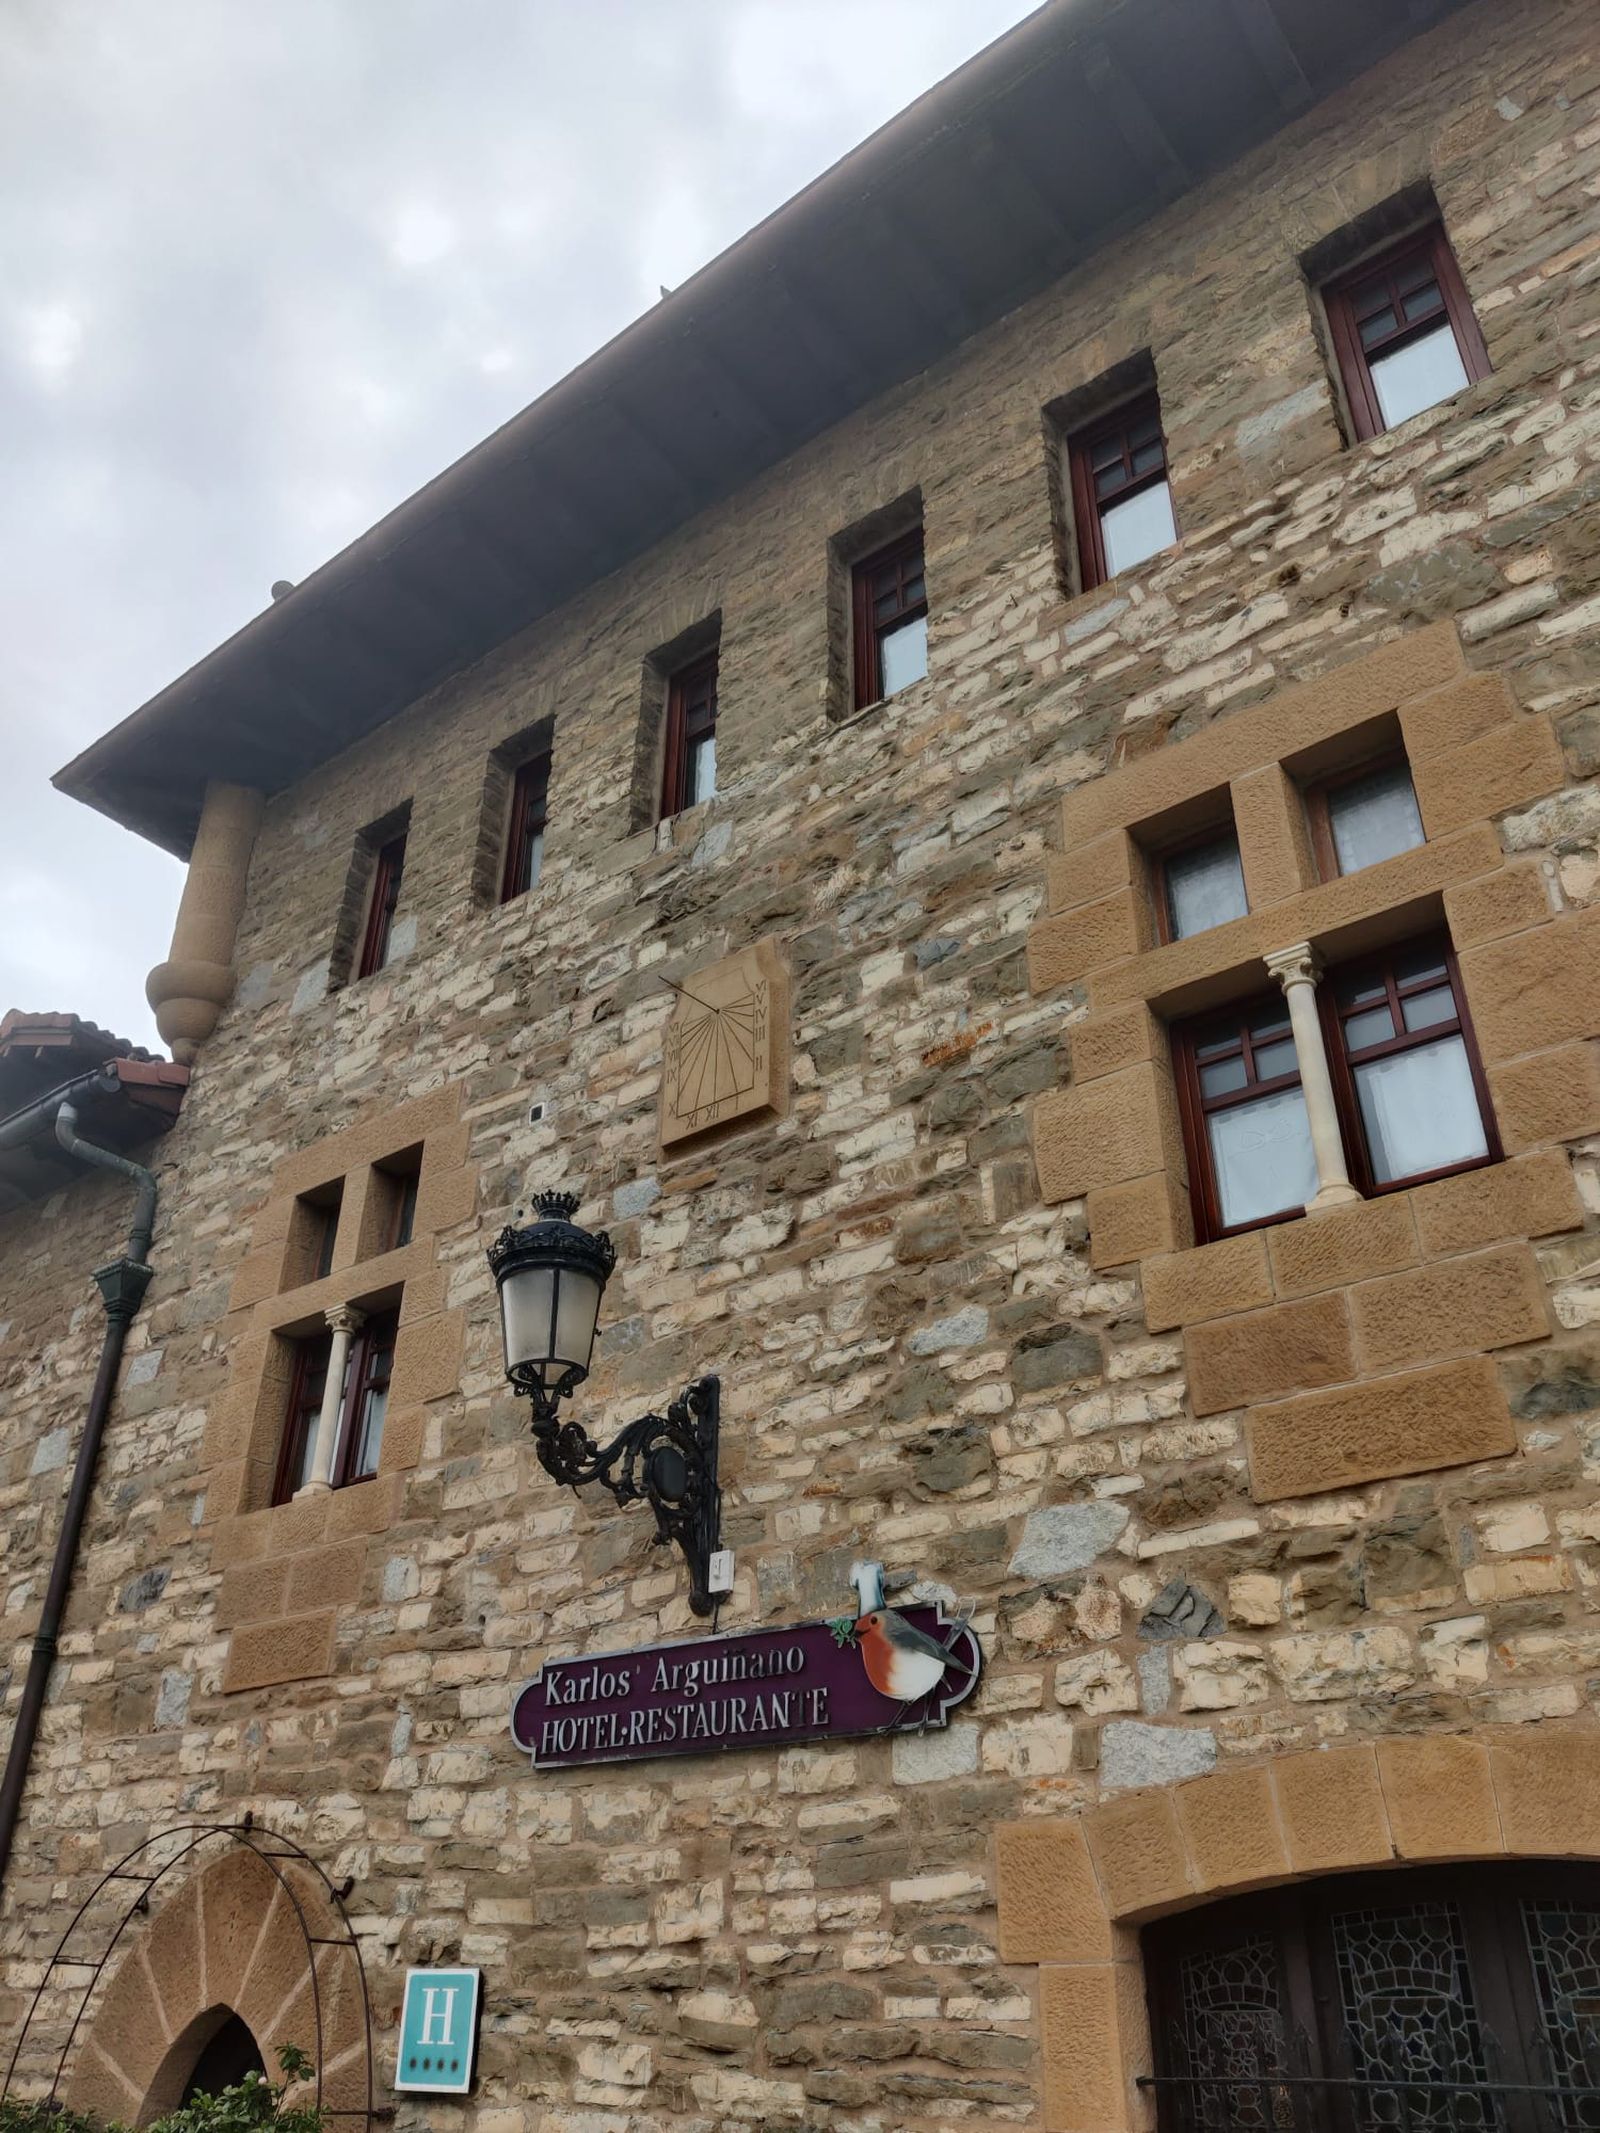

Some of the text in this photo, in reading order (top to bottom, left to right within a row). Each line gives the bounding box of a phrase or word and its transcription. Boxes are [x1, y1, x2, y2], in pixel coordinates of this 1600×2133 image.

[755, 1007, 768, 1024] IV
[755, 1024, 766, 1042] III
[755, 1054, 763, 1071] II
[667, 1100, 677, 1118] X
[705, 1103, 720, 1122] XII
[685, 1112, 698, 1130] XI
[650, 1645, 805, 1698] Arguiñano
[417, 1988, 459, 2045] H
